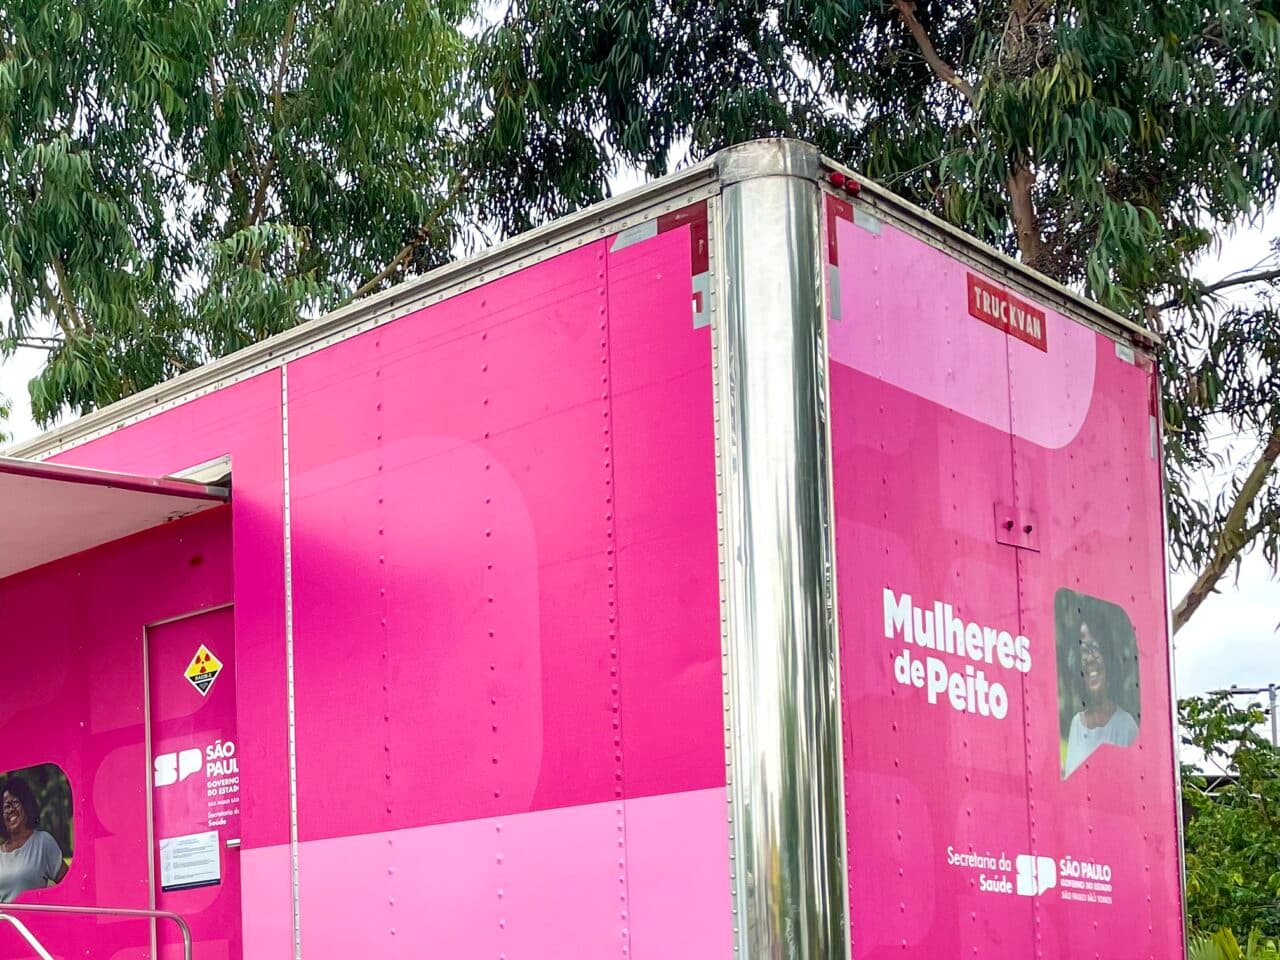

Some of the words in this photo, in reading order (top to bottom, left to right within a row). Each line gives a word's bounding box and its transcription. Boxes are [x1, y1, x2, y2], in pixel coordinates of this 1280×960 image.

[974, 286, 1041, 340] TRUCKVAN
[883, 588, 1032, 673] Mulheres
[894, 649, 925, 688] de
[926, 656, 1009, 719] Peito
[206, 740, 235, 761] SÃO
[206, 758, 239, 778] PAUL
[207, 789, 218, 797] DO
[218, 785, 239, 795] ESTAD
[947, 846, 997, 869] Secretaria
[998, 851, 1012, 872] da
[1060, 856, 1080, 878] SÃO
[1080, 862, 1111, 882] PAULO
[979, 873, 1013, 894] Saúde
